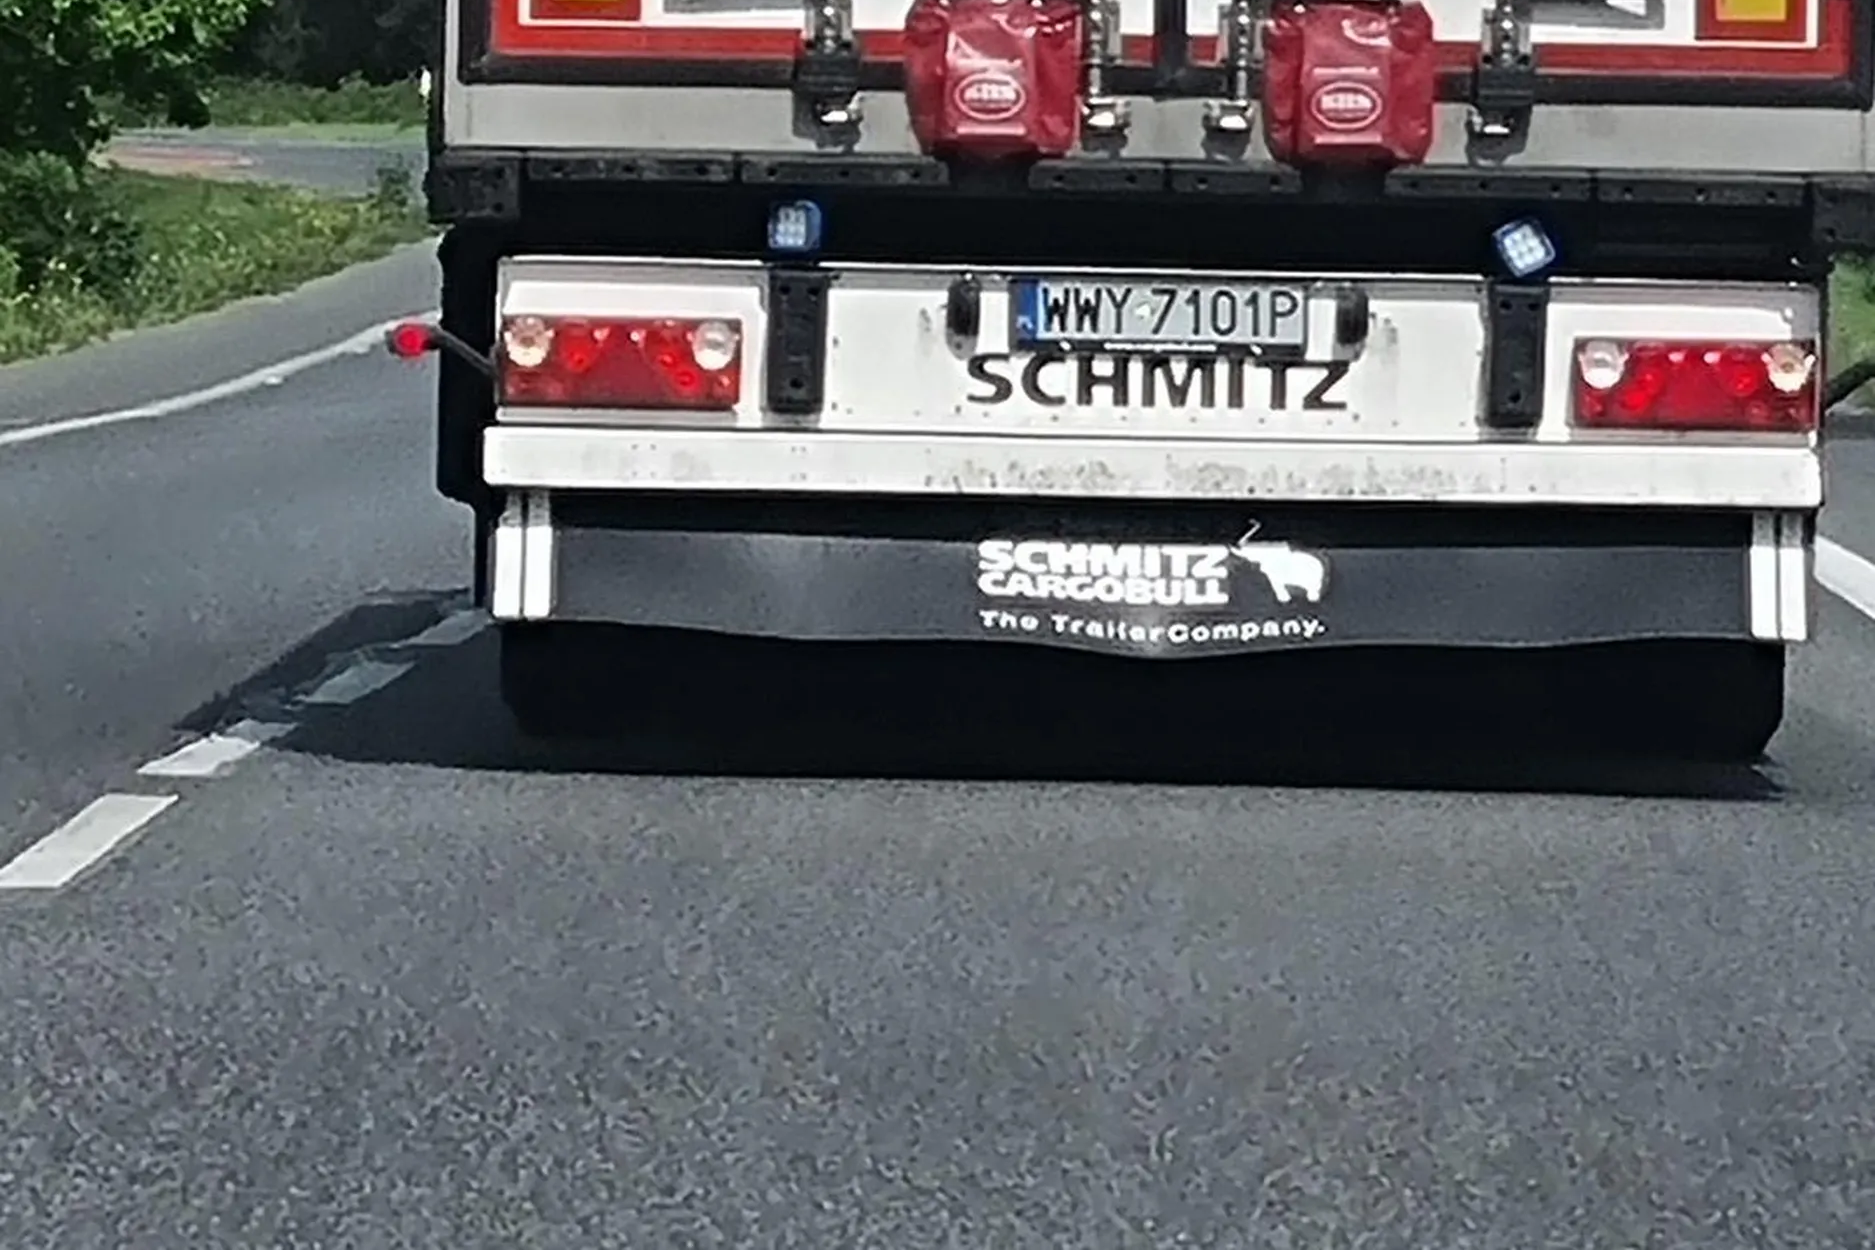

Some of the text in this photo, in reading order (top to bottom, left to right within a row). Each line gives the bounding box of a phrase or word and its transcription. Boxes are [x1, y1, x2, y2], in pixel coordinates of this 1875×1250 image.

[1042, 287, 1300, 338] WWY 7101P
[966, 352, 1350, 410] SCHMITZ
[977, 540, 1230, 579] SCHMITZ
[977, 571, 1230, 606] CARGOBULL
[979, 609, 1039, 631] The
